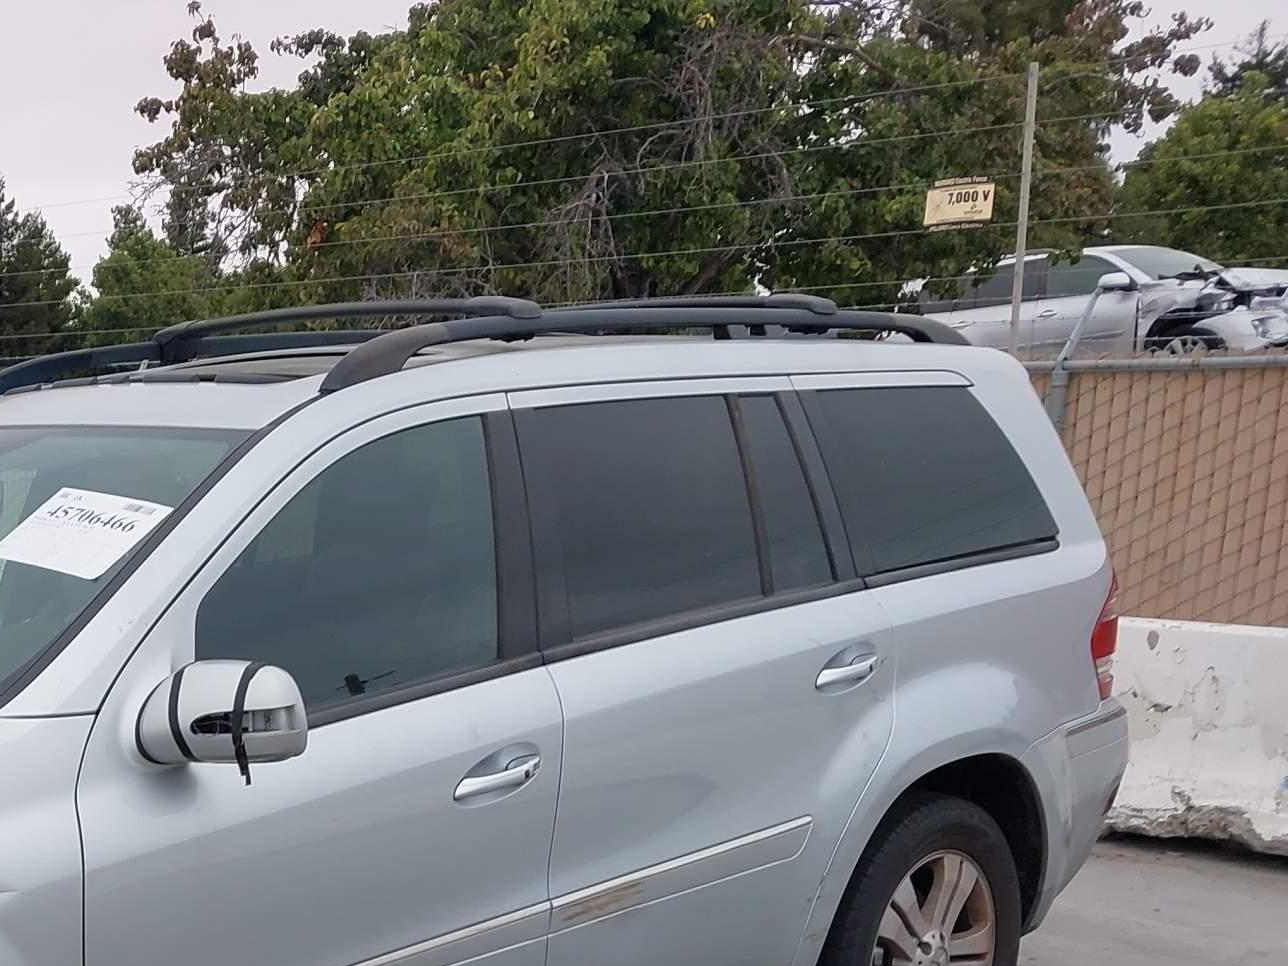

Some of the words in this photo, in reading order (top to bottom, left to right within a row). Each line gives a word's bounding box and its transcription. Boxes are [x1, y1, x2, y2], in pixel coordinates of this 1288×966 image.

[947, 190, 979, 206] 7,000
[983, 189, 991, 202] V
[47, 504, 140, 534] 45706466
